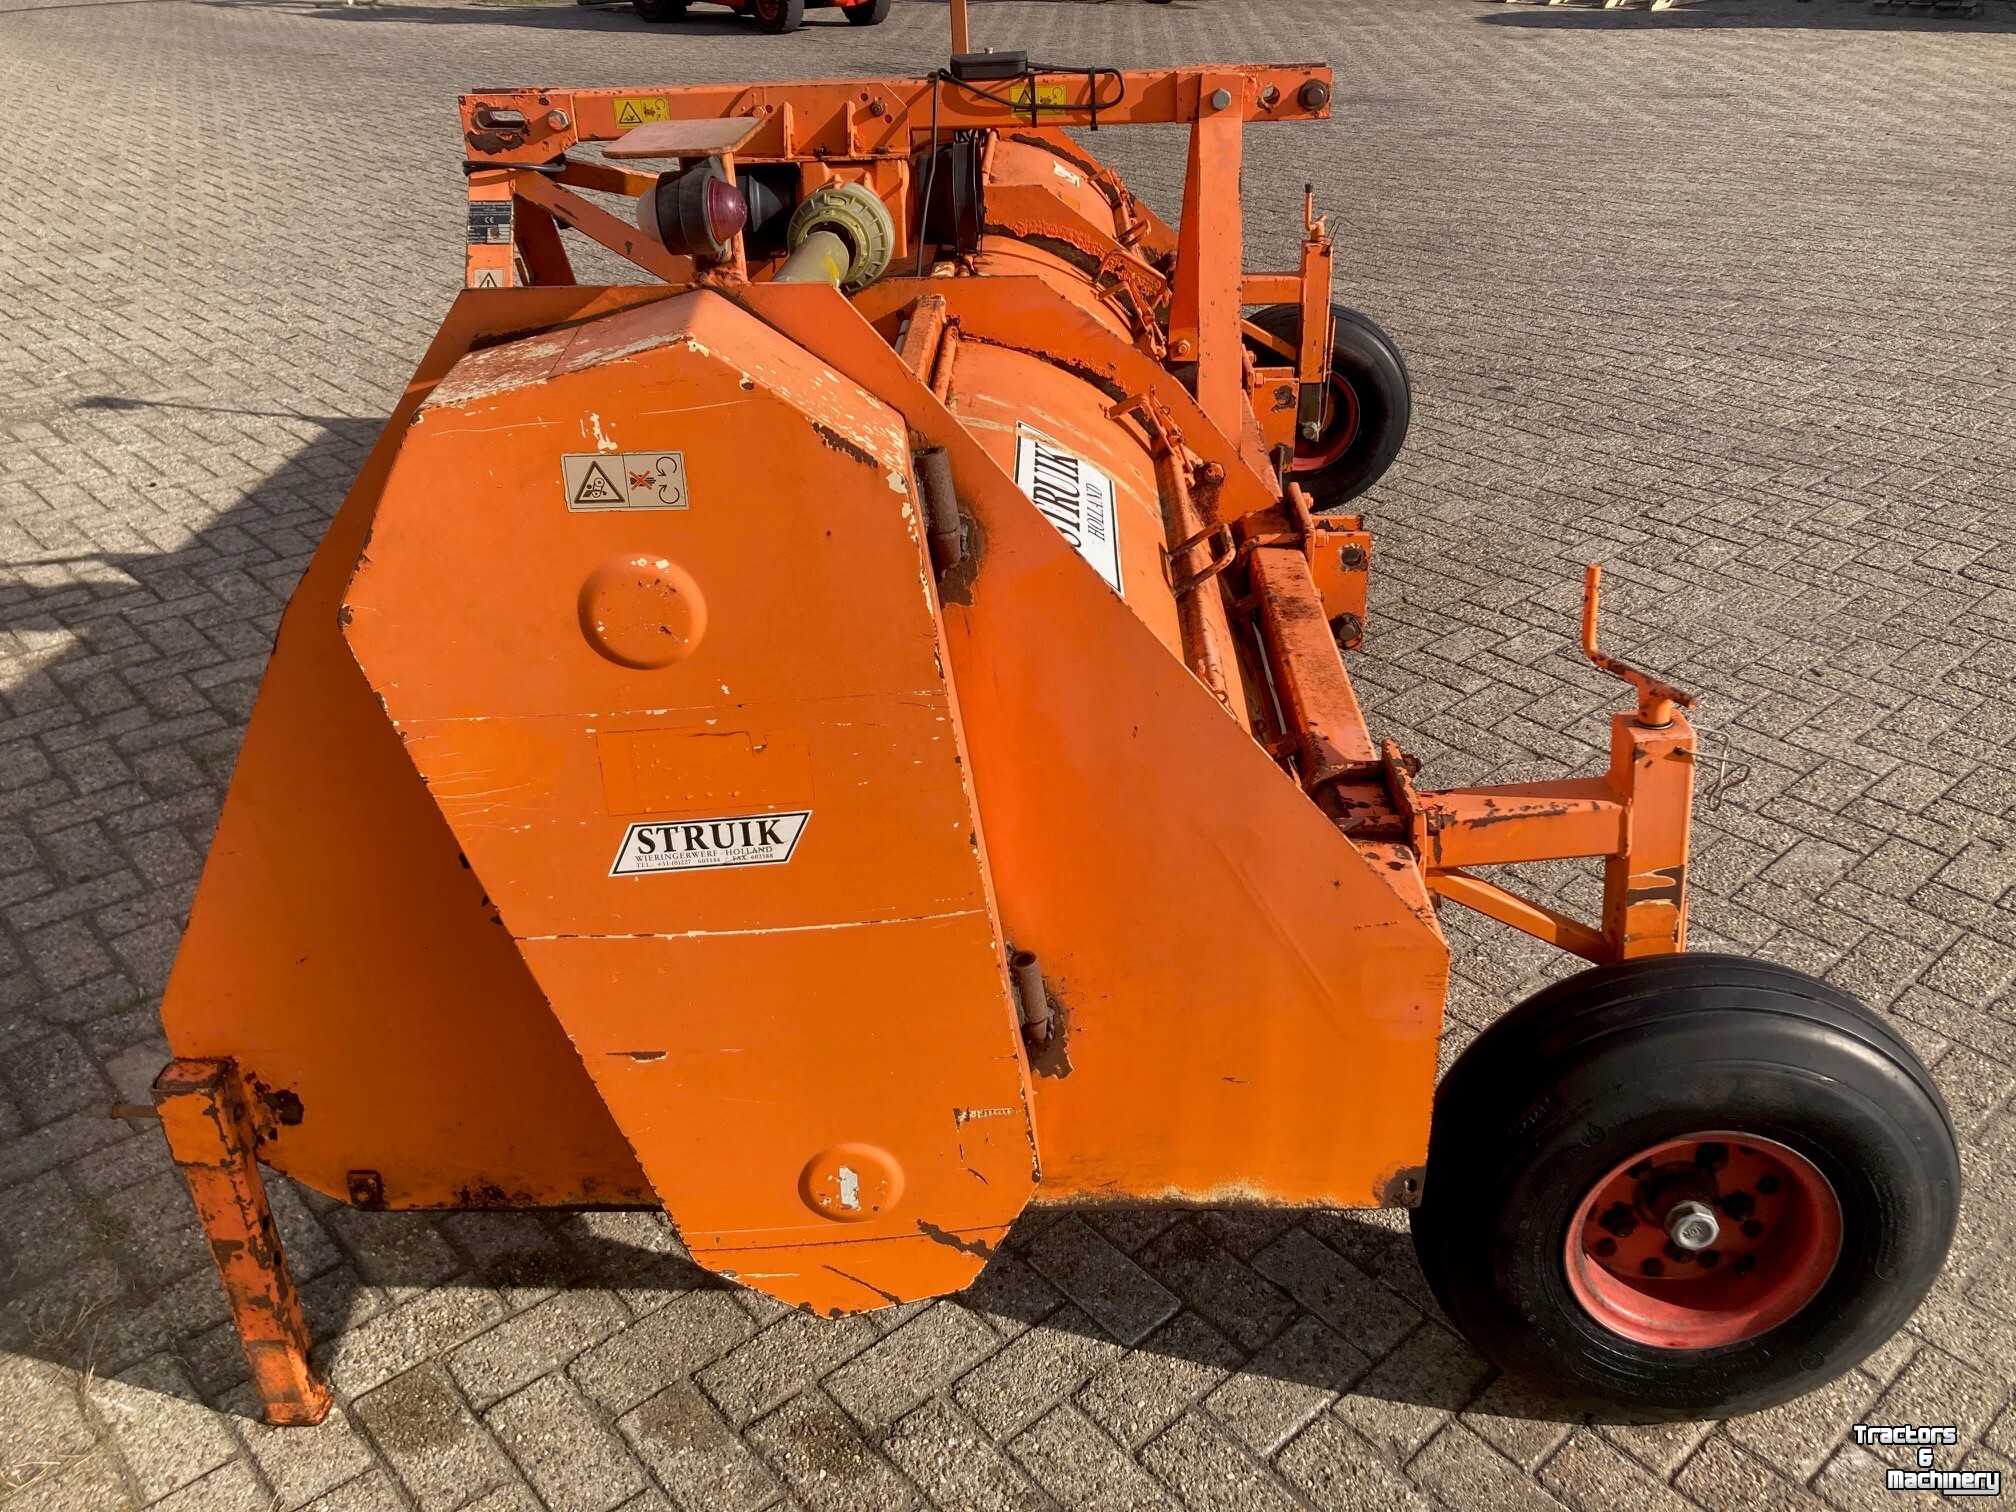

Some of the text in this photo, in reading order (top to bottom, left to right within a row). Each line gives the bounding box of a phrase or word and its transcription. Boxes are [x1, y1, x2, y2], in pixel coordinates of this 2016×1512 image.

[1086, 482, 1105, 541] HOLLAND
[635, 850, 718, 862] WIERINGERWERF
[725, 845, 773, 856] HOLLAND
[637, 819, 785, 855] STRUIK
